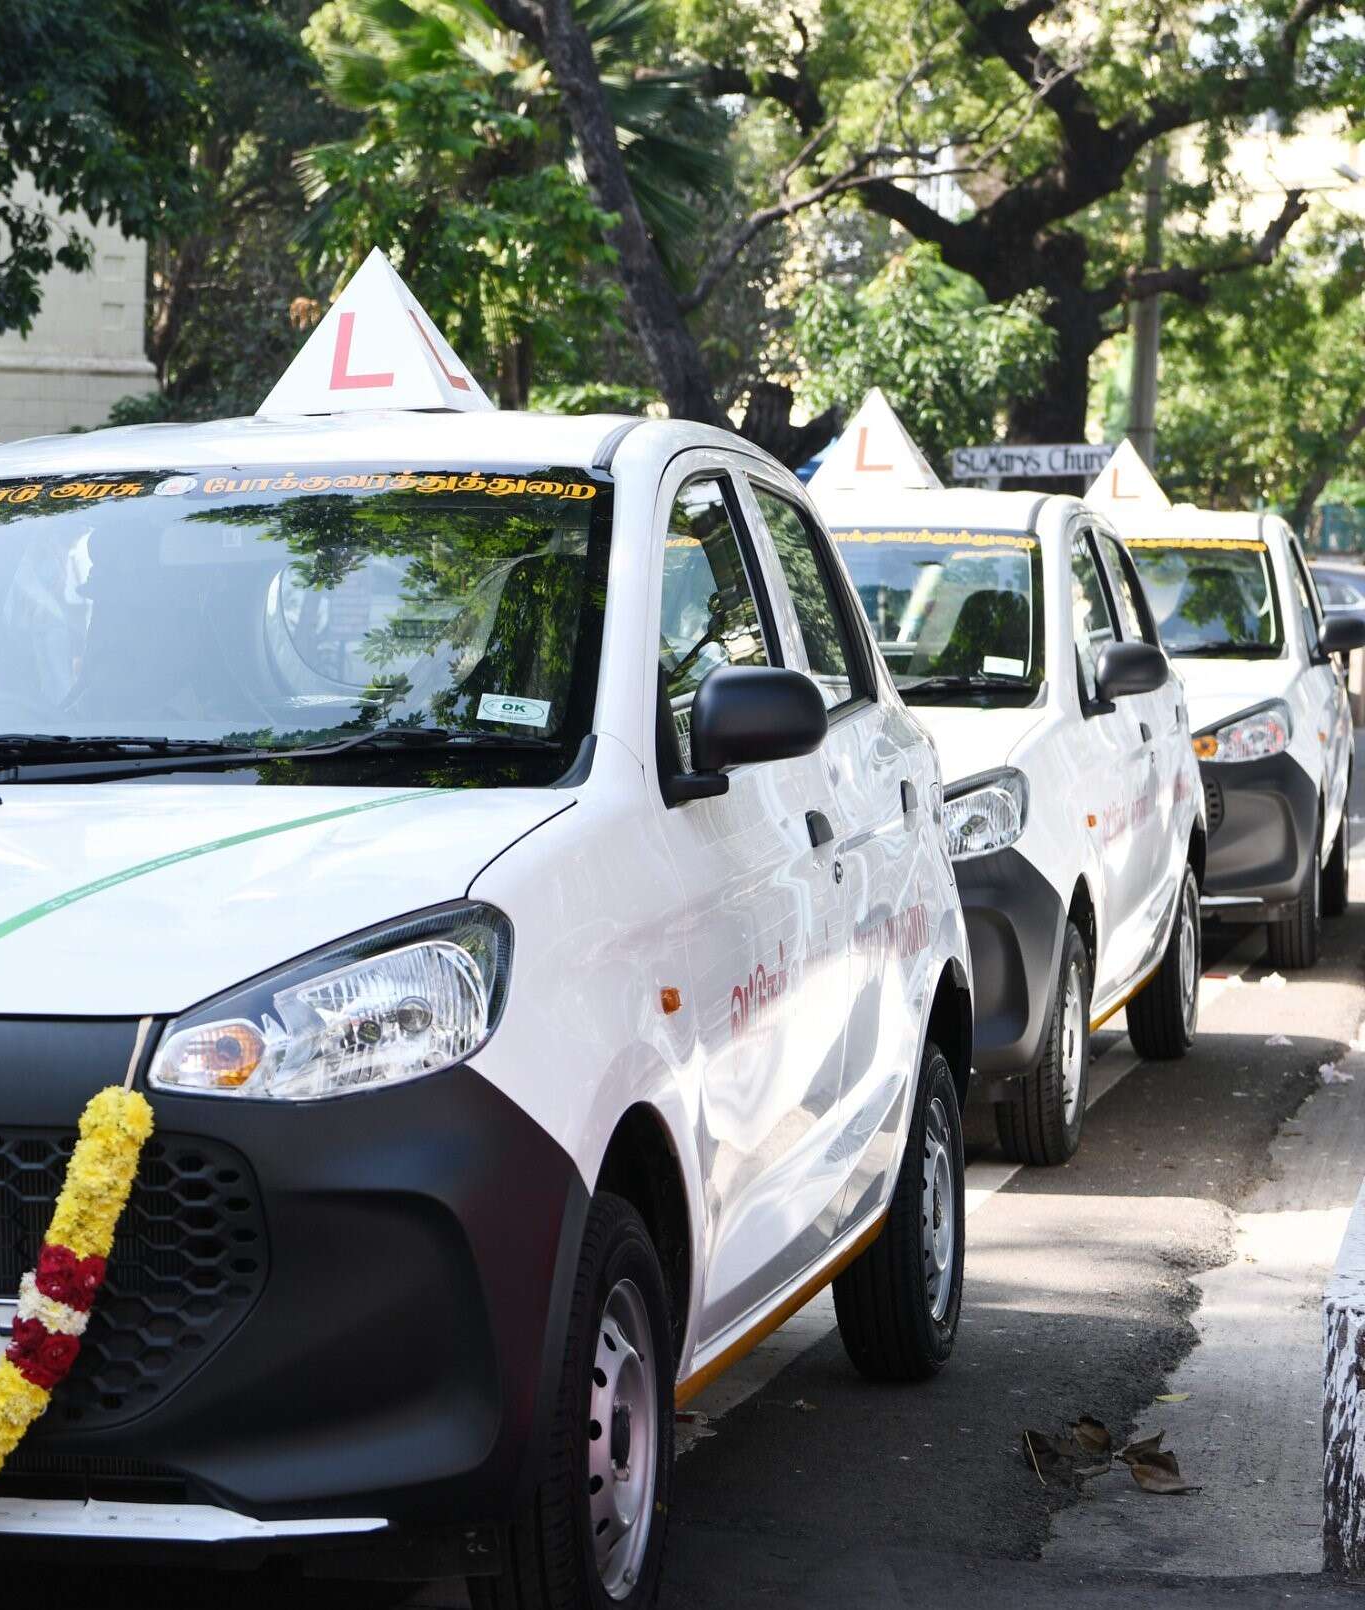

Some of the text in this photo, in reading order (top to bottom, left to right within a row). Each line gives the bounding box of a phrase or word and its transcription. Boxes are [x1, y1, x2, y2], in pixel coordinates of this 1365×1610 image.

[329, 312, 394, 390] L
[854, 427, 894, 472] L
[1047, 446, 1117, 473] Churc
[501, 703, 526, 713] OK
